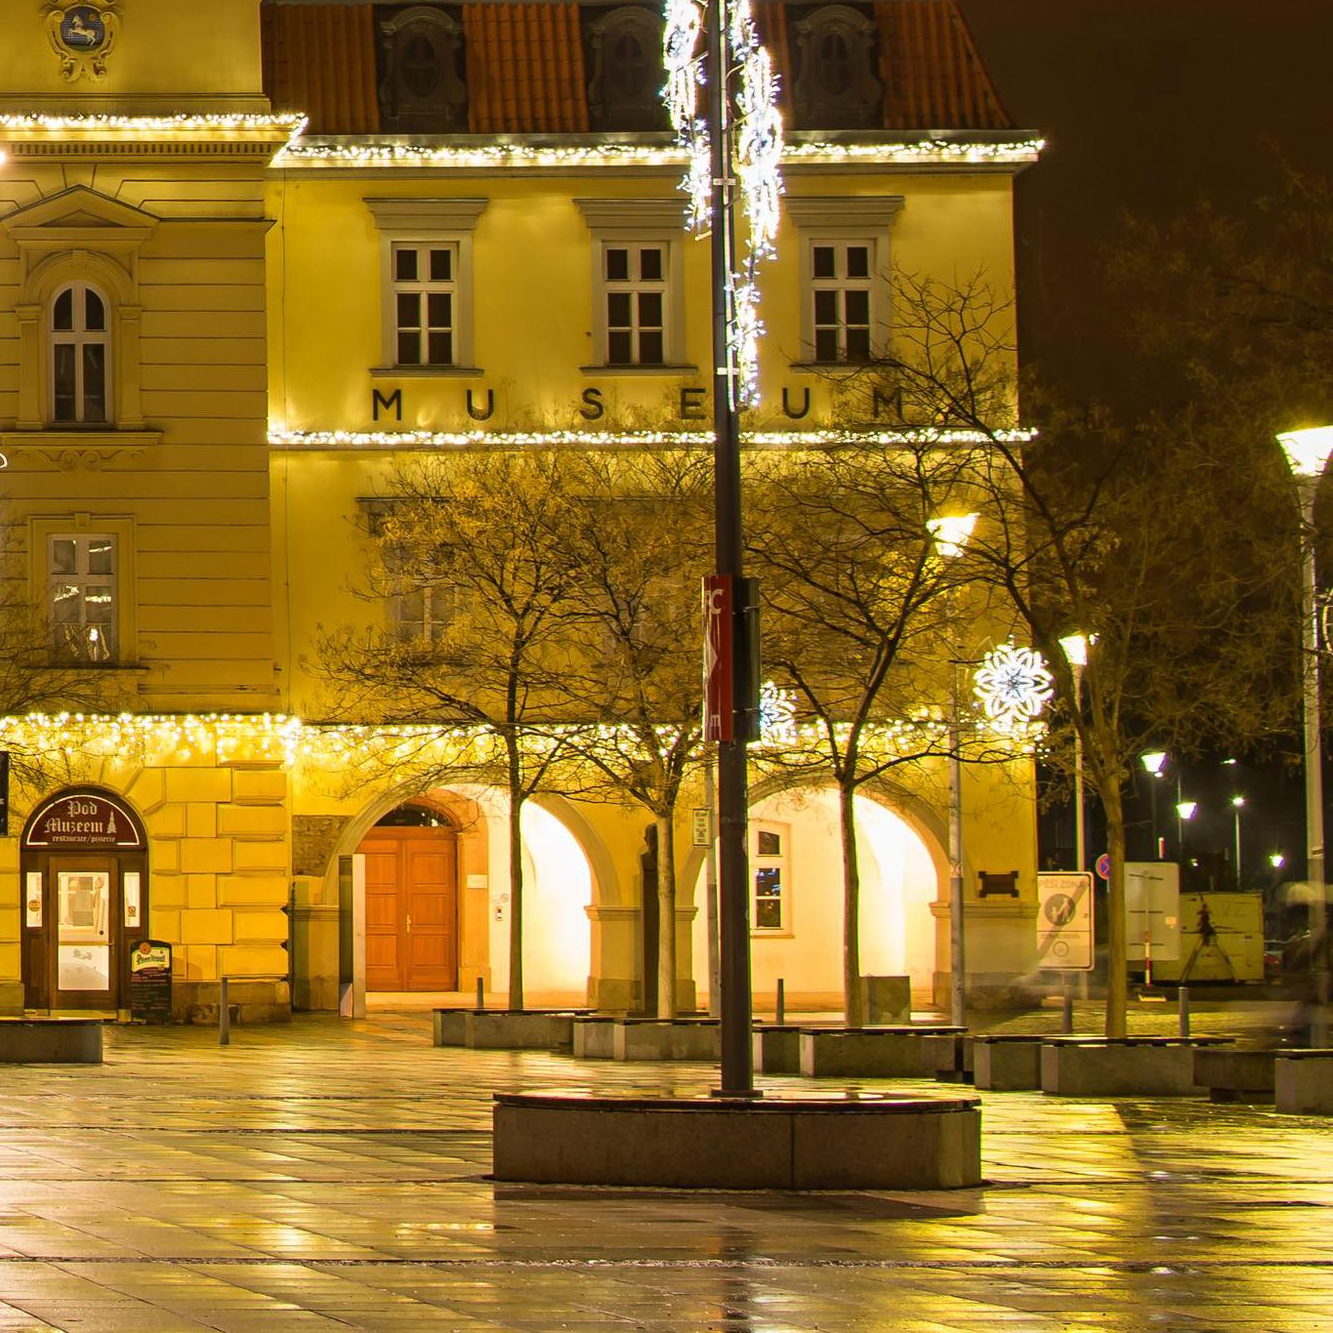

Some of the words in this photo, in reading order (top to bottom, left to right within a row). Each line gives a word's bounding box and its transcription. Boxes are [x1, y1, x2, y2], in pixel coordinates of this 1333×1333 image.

[372, 388, 902, 421] MUSEUM
[67, 800, 99, 818] Pod
[44, 817, 104, 834] Muzeem
